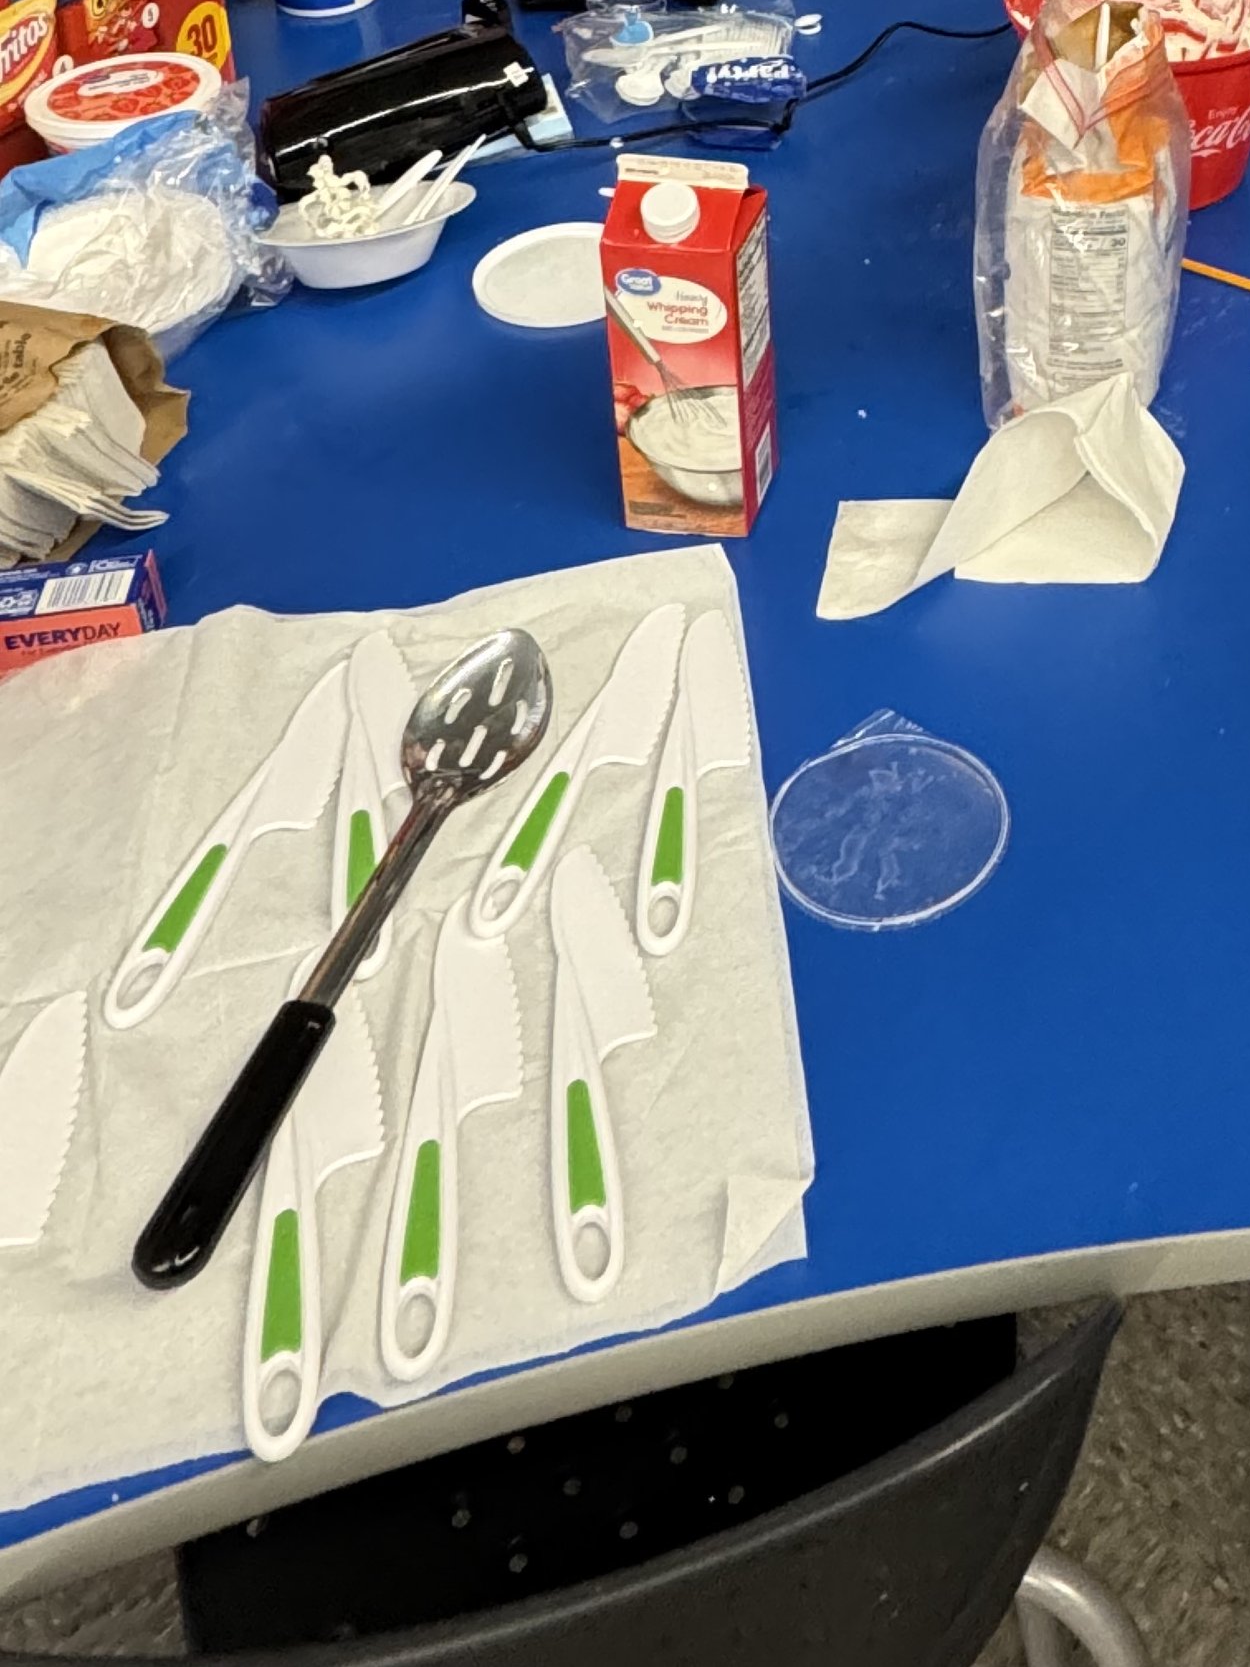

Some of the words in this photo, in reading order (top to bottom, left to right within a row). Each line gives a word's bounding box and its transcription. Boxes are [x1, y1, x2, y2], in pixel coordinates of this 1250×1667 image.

[187, 14, 218, 57] 30
[647, 301, 708, 317] Whipping
[664, 314, 709, 326] Cream
[5, 622, 121, 650] EVERYDAY
